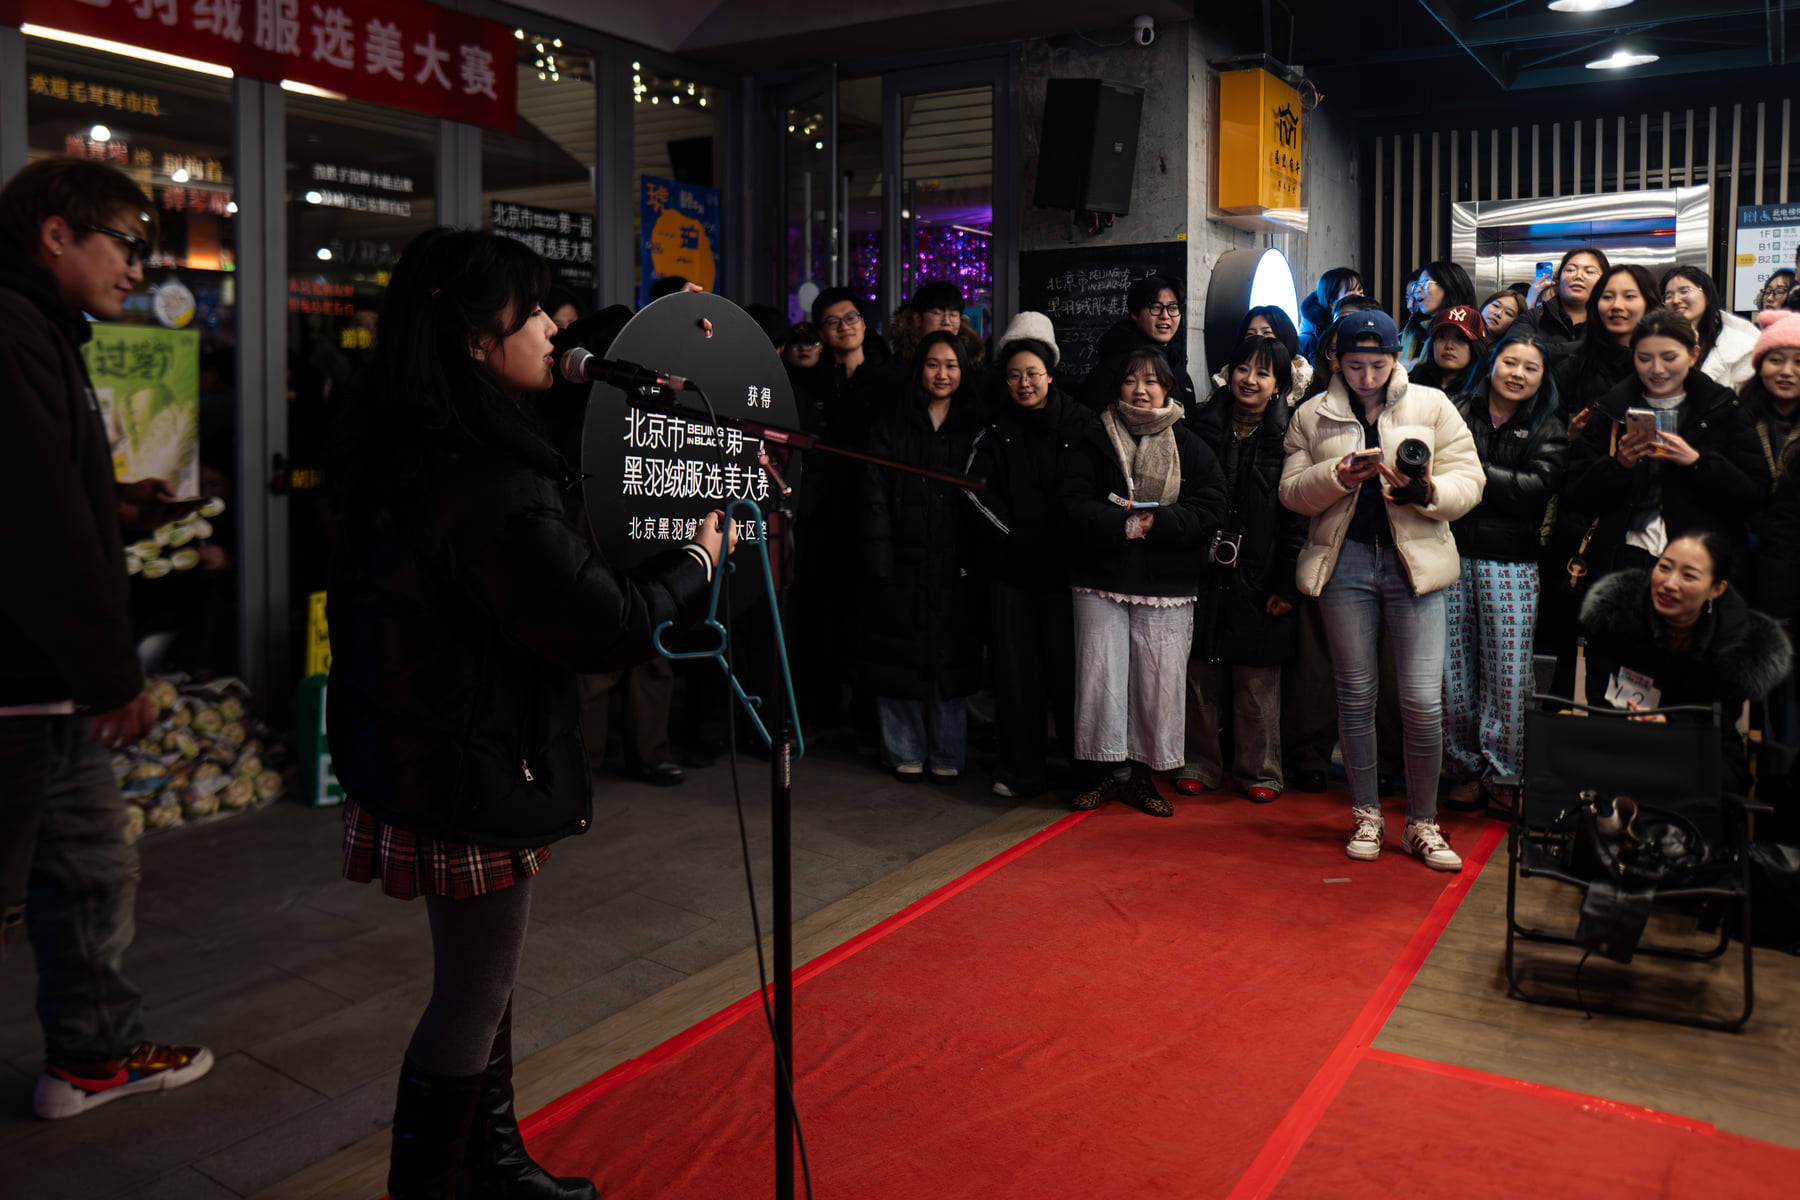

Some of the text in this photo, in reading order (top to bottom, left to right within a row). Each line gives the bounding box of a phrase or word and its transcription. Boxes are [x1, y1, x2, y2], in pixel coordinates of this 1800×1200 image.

[493, 203, 533, 230] 北京市
[1760, 230, 1771, 238] 1F
[1759, 243, 1771, 251] B1
[1758, 256, 1771, 264] B2
[1047, 270, 1089, 293] 北京市
[747, 385, 772, 409] 获得
[623, 407, 766, 457] 北京市 BEIJING 第一
[686, 436, 725, 448] IN BLACK
